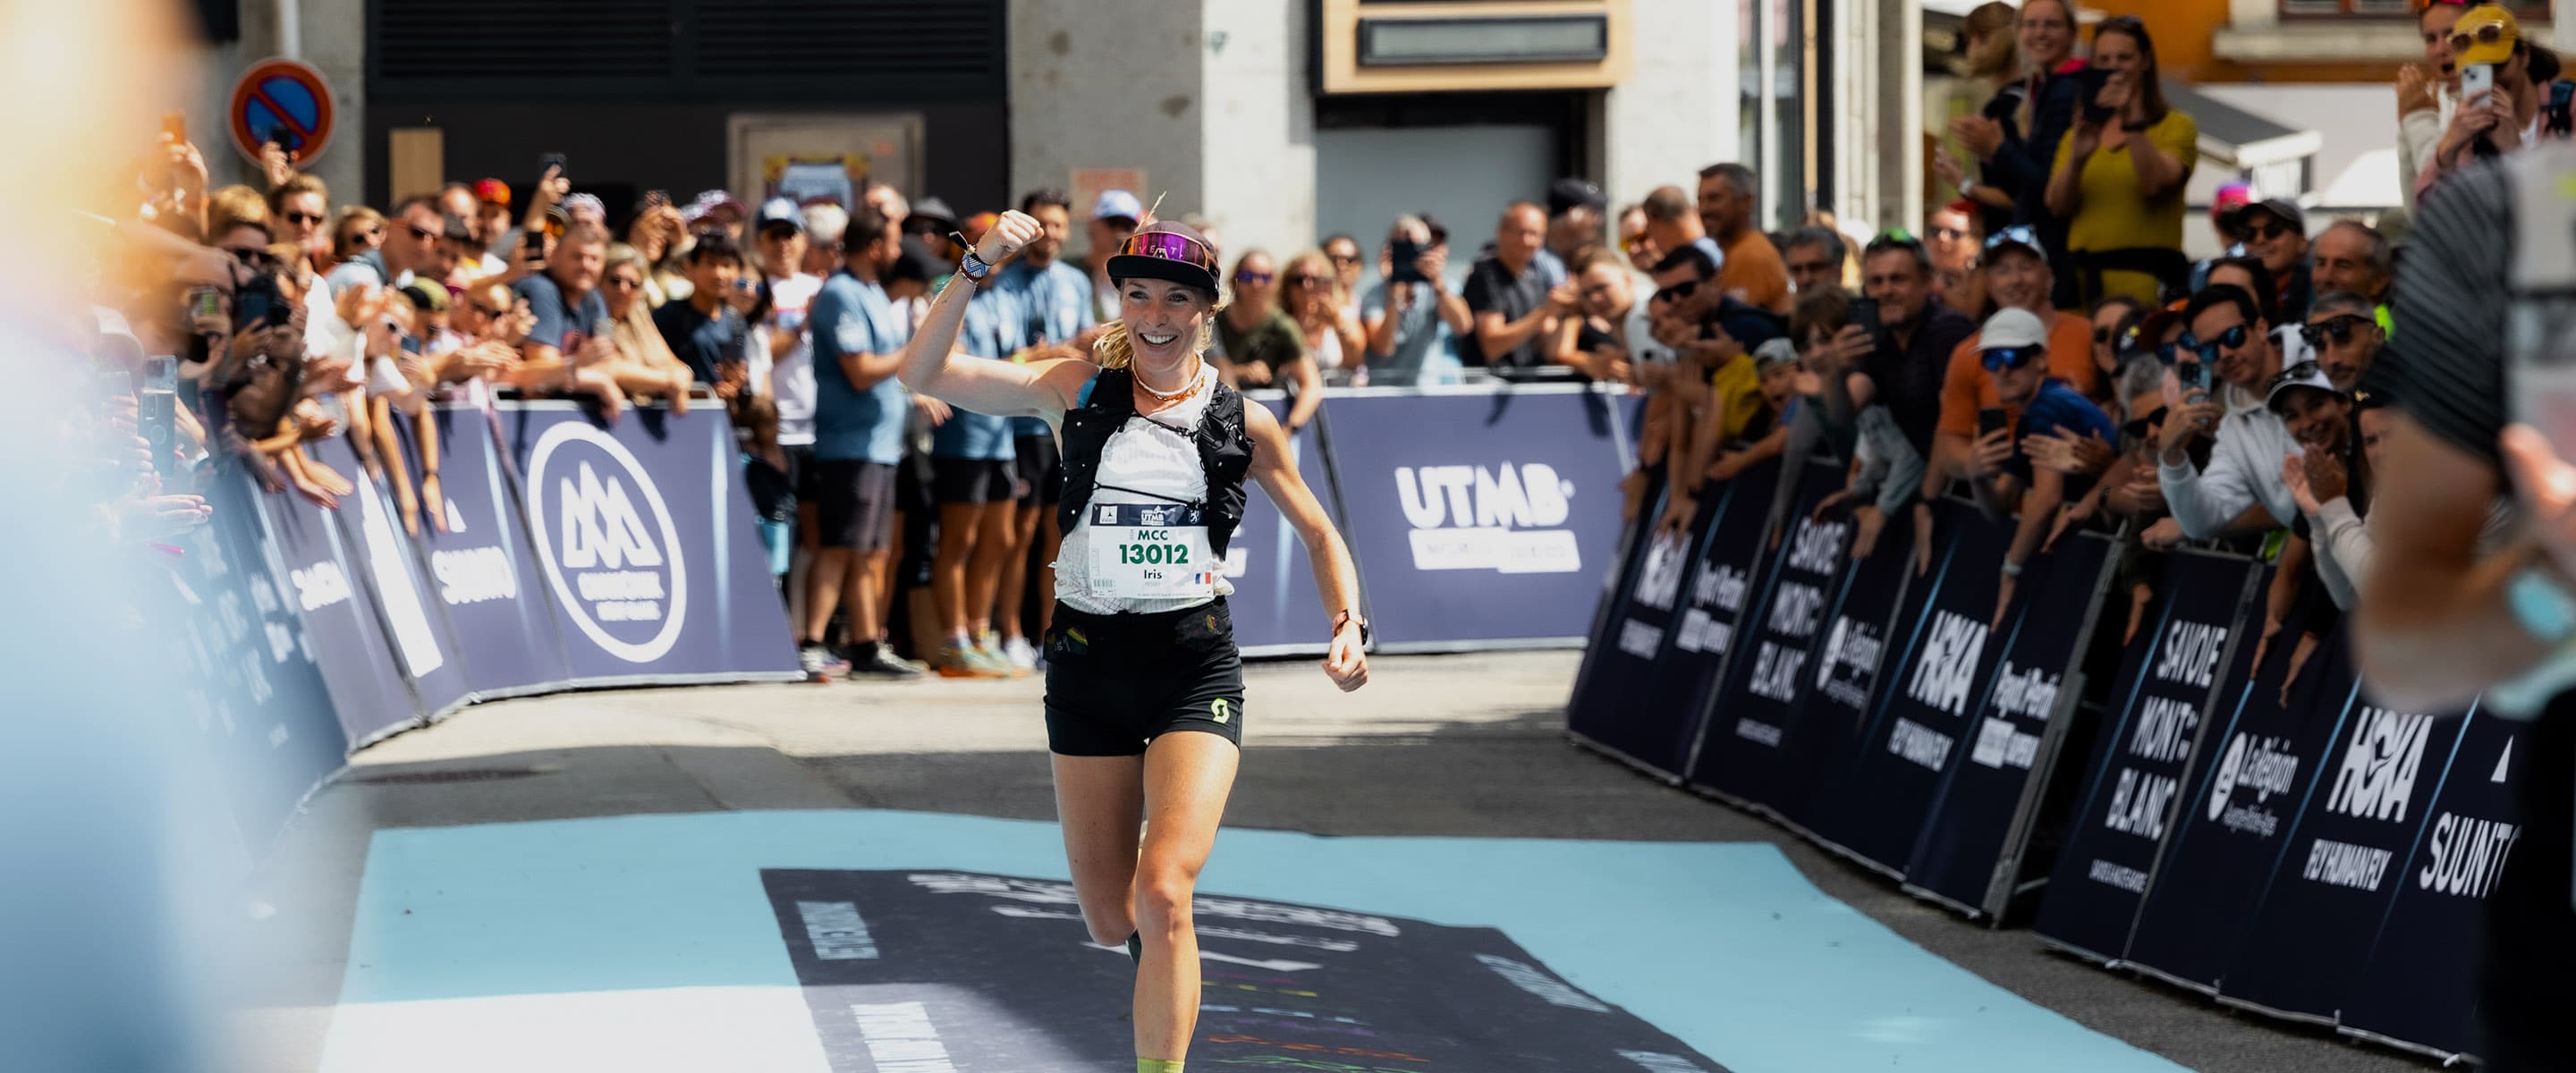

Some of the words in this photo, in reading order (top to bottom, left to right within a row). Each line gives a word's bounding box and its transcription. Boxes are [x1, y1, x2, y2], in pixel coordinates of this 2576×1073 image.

[1394, 460, 1570, 529] UTMB
[1119, 544, 1189, 564] 13012
[1137, 529, 1168, 541] MCC
[1144, 569, 1163, 579] Iris
[1907, 610, 1989, 717] HOKA
[2157, 620, 2228, 689] SAVOIE
[2129, 695, 2193, 763] MONT
[2326, 706, 2435, 824] HOKA
[2105, 766, 2178, 841] BLANC
[2302, 838, 2334, 881] FLY
[2320, 841, 2373, 890] HUMAN
[2361, 848, 2394, 892] FLY
